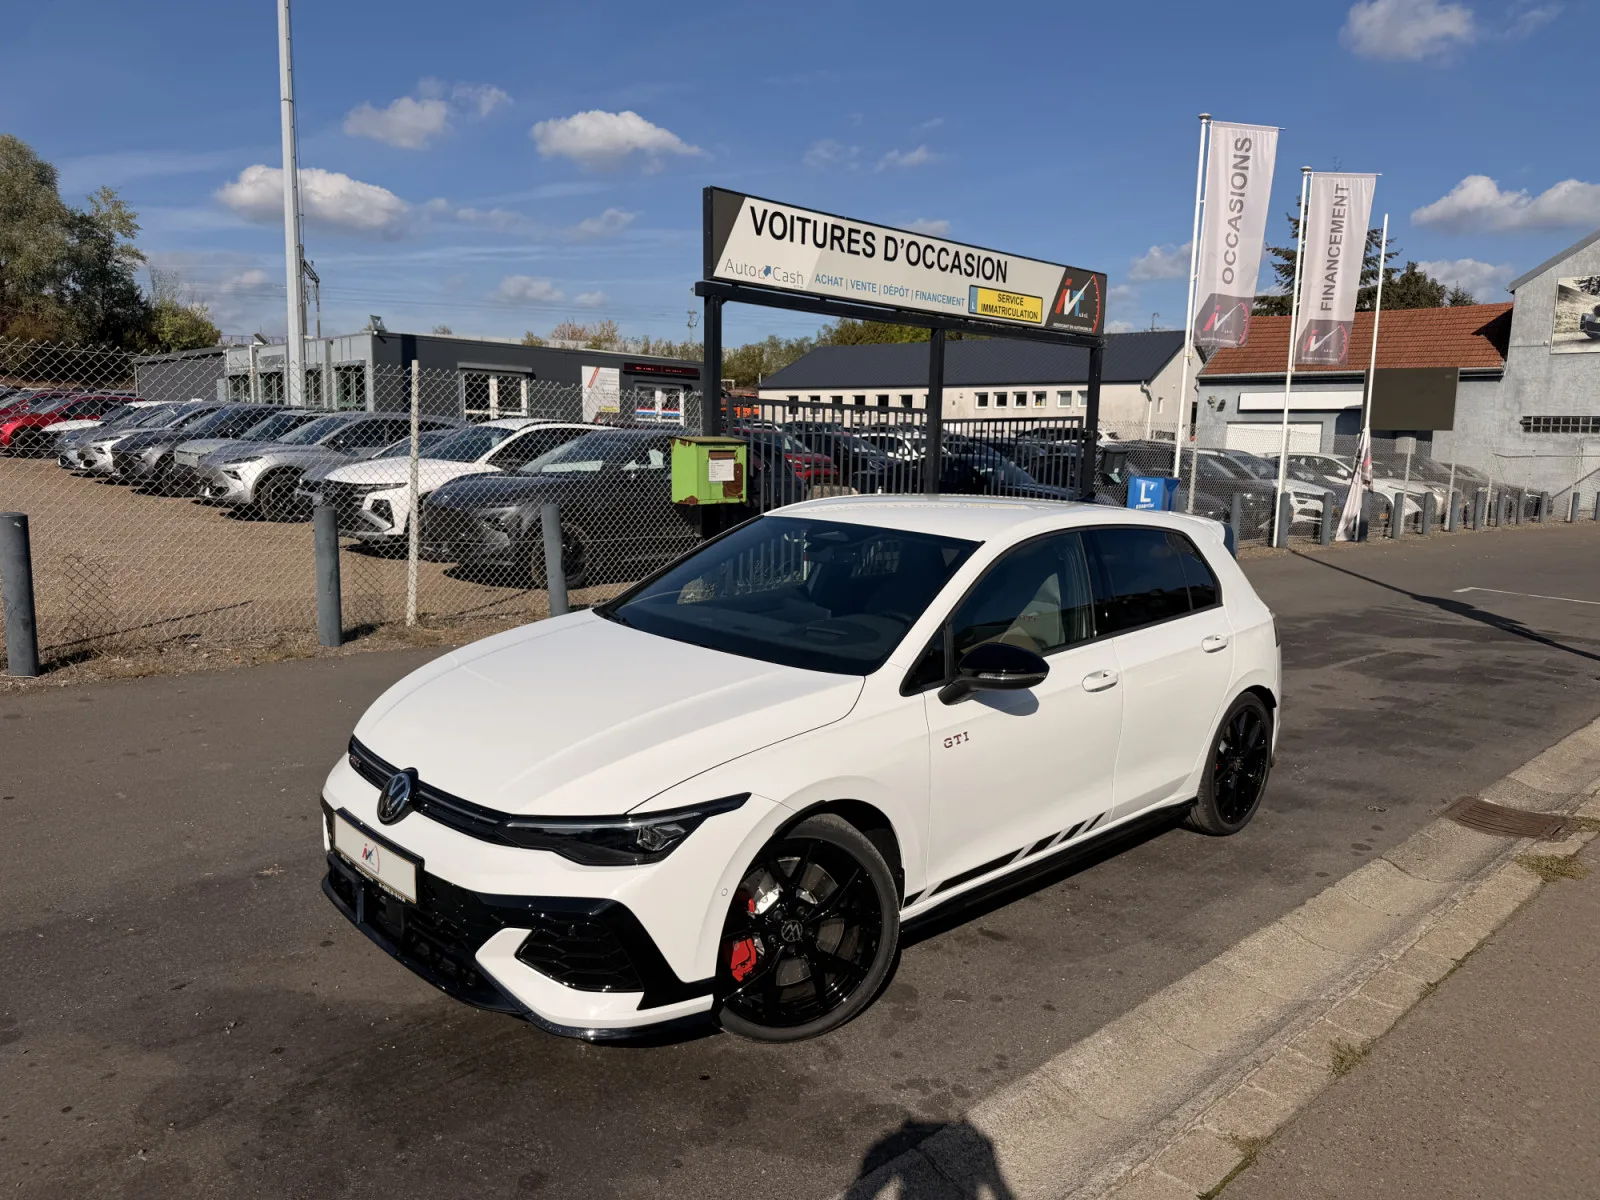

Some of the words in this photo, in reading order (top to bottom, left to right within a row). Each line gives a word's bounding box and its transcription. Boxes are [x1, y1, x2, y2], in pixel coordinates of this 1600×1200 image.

[1222, 137, 1252, 285] OCCASIONS
[750, 205, 876, 258] VOITURES
[884, 235, 1007, 284] D'OCCASION
[1320, 183, 1349, 311] FINANCEMENT
[724, 258, 756, 277] Auto
[773, 266, 804, 285] Cash
[815, 273, 844, 287] ACHAT
[850, 279, 877, 293] VENTE
[883, 284, 909, 298] DÉPÔT
[915, 290, 965, 307] FINANCEMENT
[997, 293, 1024, 306] SERVICE
[971, 301, 976, 310] L
[981, 303, 1038, 320] IMMATRICULATION
[943, 731, 969, 748] GTI
